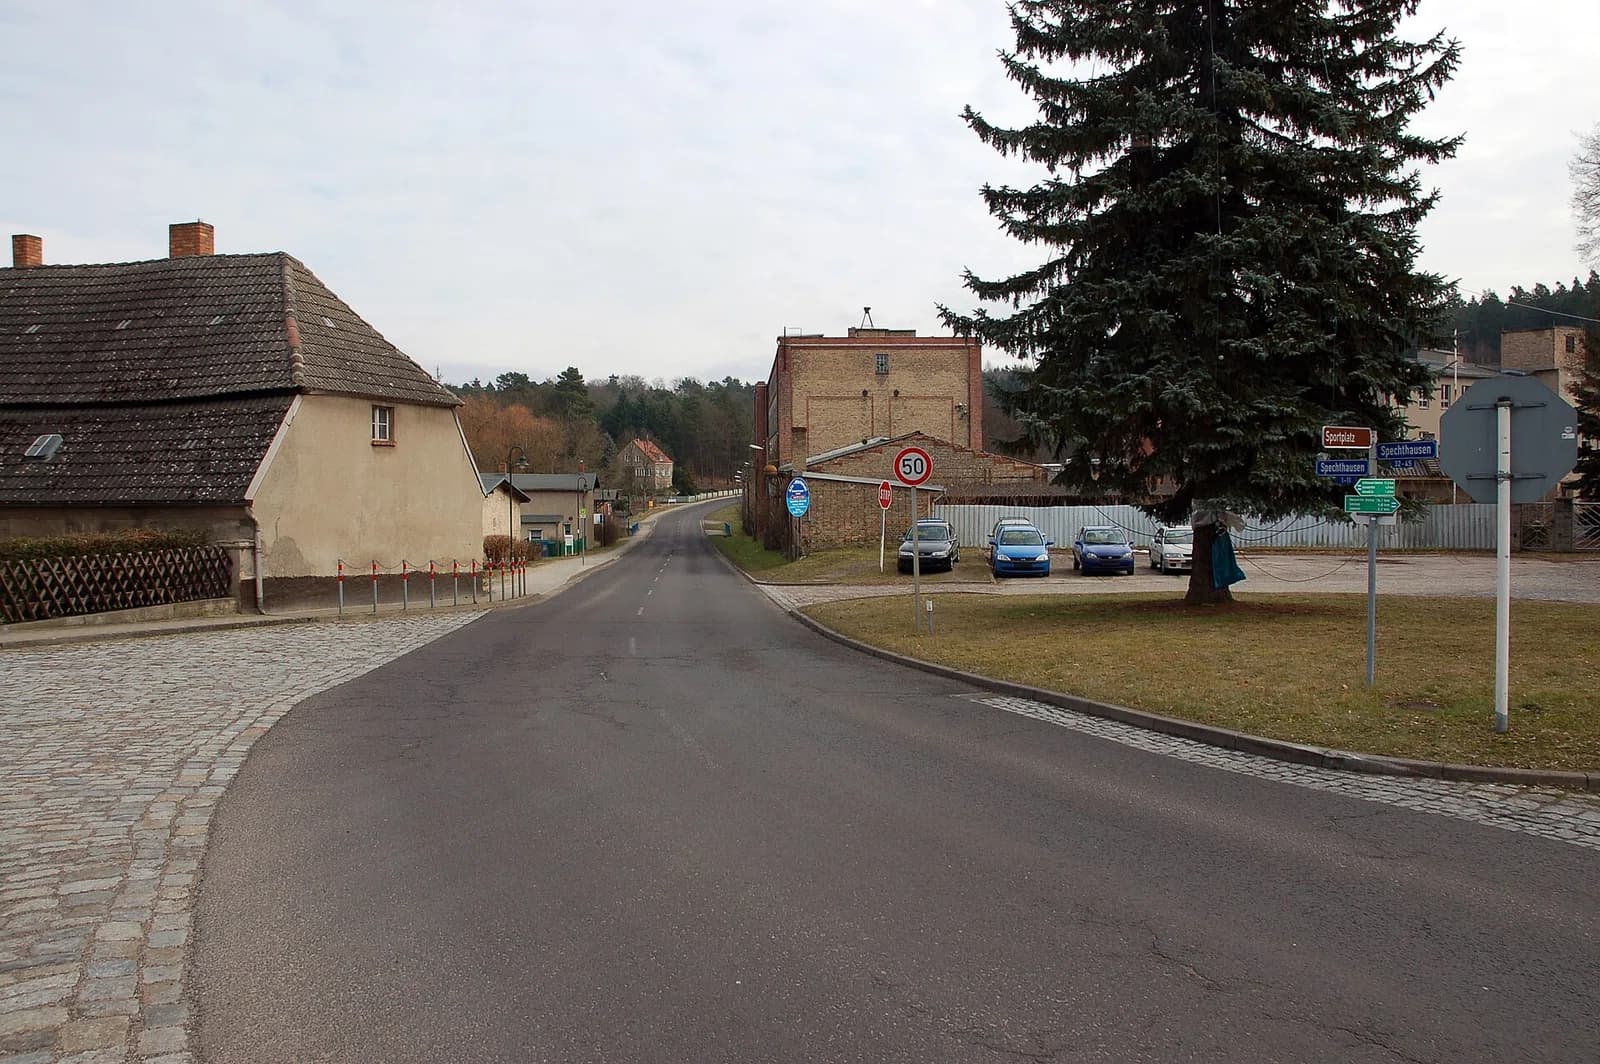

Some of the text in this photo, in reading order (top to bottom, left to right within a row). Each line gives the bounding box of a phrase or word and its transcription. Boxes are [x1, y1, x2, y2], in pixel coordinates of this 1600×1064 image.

[1325, 431, 1356, 445] Sportplatz
[1380, 445, 1432, 459] Spechthausen
[902, 457, 924, 475] 50
[1320, 462, 1365, 475] Spechthausen
[880, 489, 891, 500] STOP
